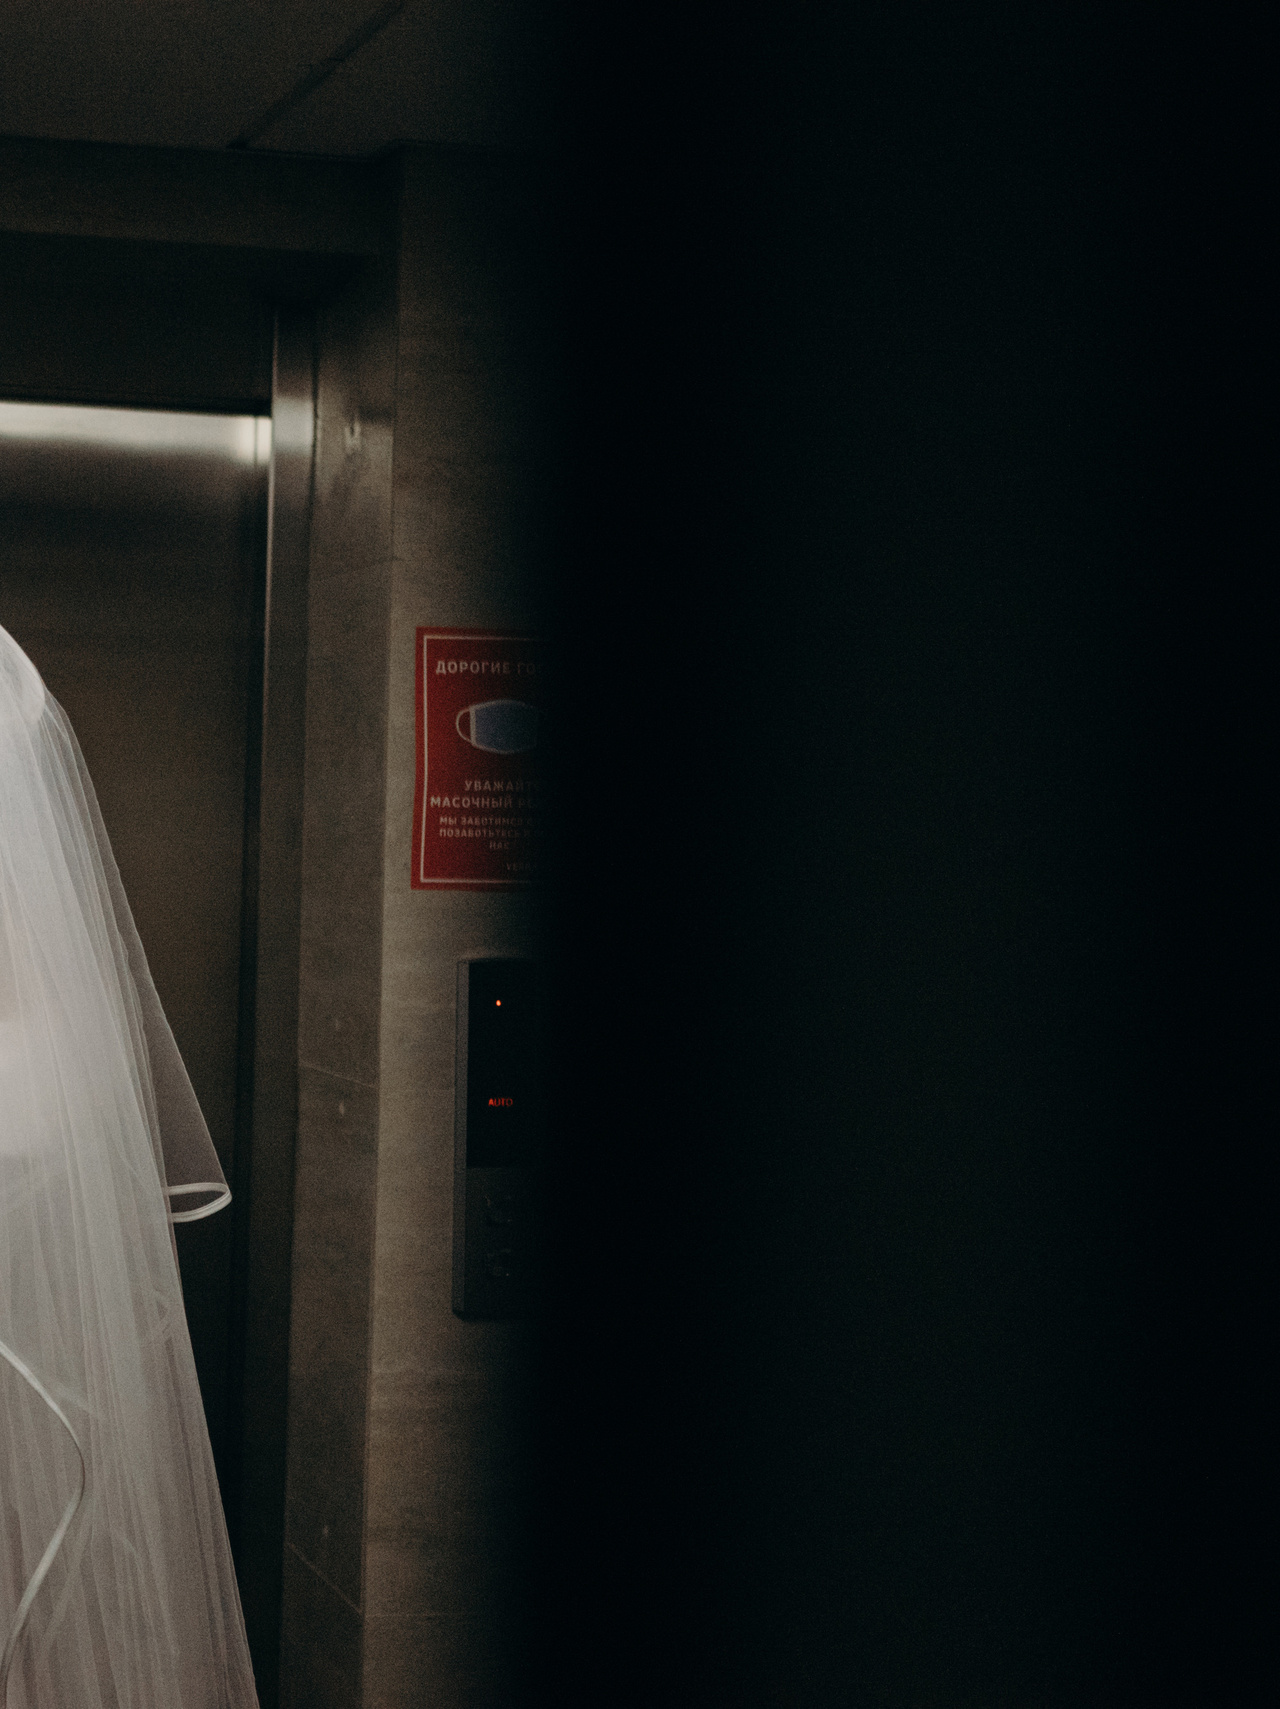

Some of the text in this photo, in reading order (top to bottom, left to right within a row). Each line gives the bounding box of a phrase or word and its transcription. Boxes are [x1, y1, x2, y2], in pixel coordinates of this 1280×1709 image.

[435, 660, 510, 675] ДОРОГИЕ
[430, 795, 513, 809] МАСОЧНЫЙ
[439, 816, 457, 826] МЫ
[488, 1097, 513, 1107] AUTO
